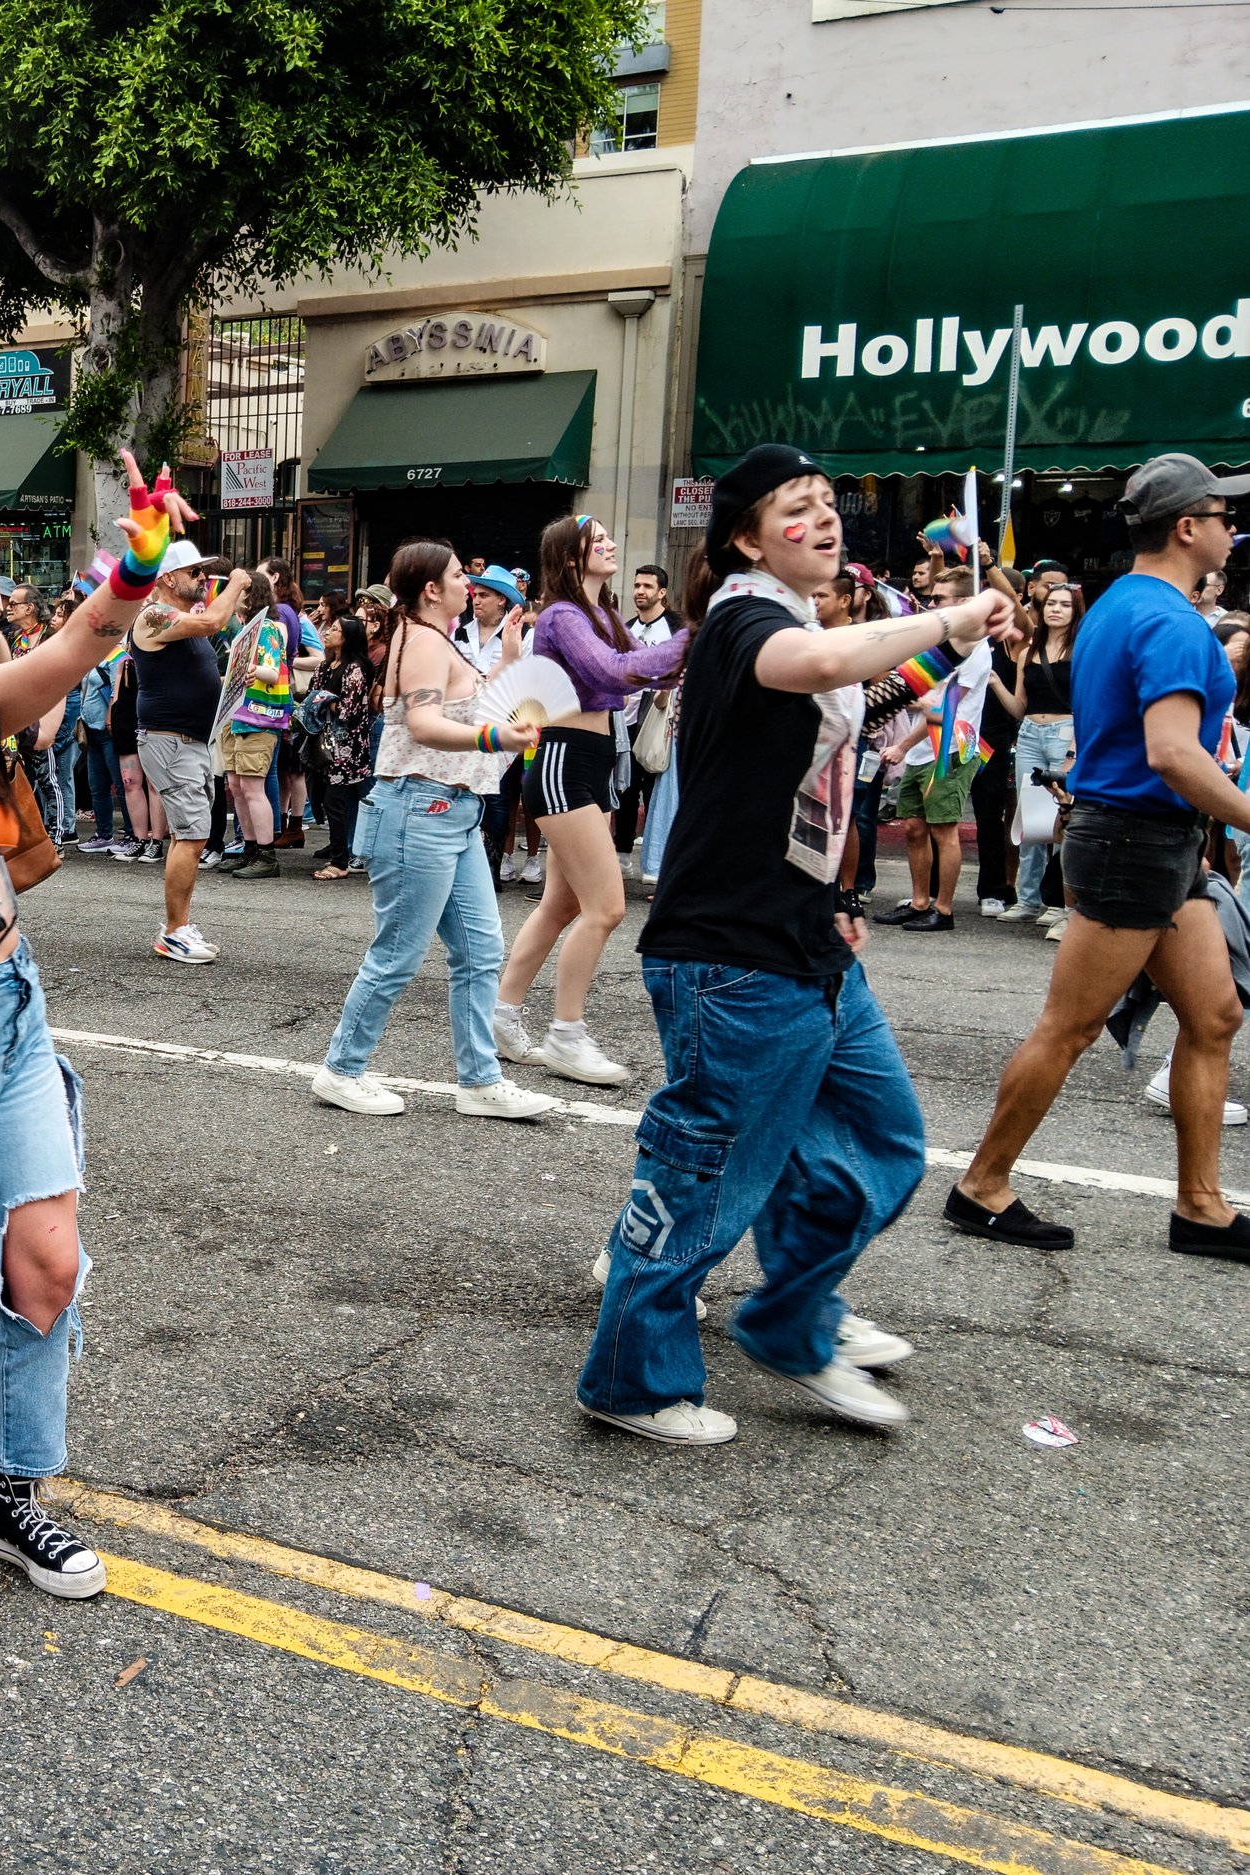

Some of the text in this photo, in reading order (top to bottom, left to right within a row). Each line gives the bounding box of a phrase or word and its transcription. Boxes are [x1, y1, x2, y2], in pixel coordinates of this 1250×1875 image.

[367, 320, 534, 372] ABYSSINIA
[801, 298, 1250, 386] Hollywood
[225, 452, 241, 461] FOR
[244, 450, 271, 459] LEASE
[236, 462, 267, 475] Pacific
[407, 468, 442, 480] 6727
[243, 477, 266, 488] West
[20, 494, 65, 504] ARTISAN'S PATIO
[223, 496, 271, 508] 818-244-3000
[43, 524, 72, 538] ATM
